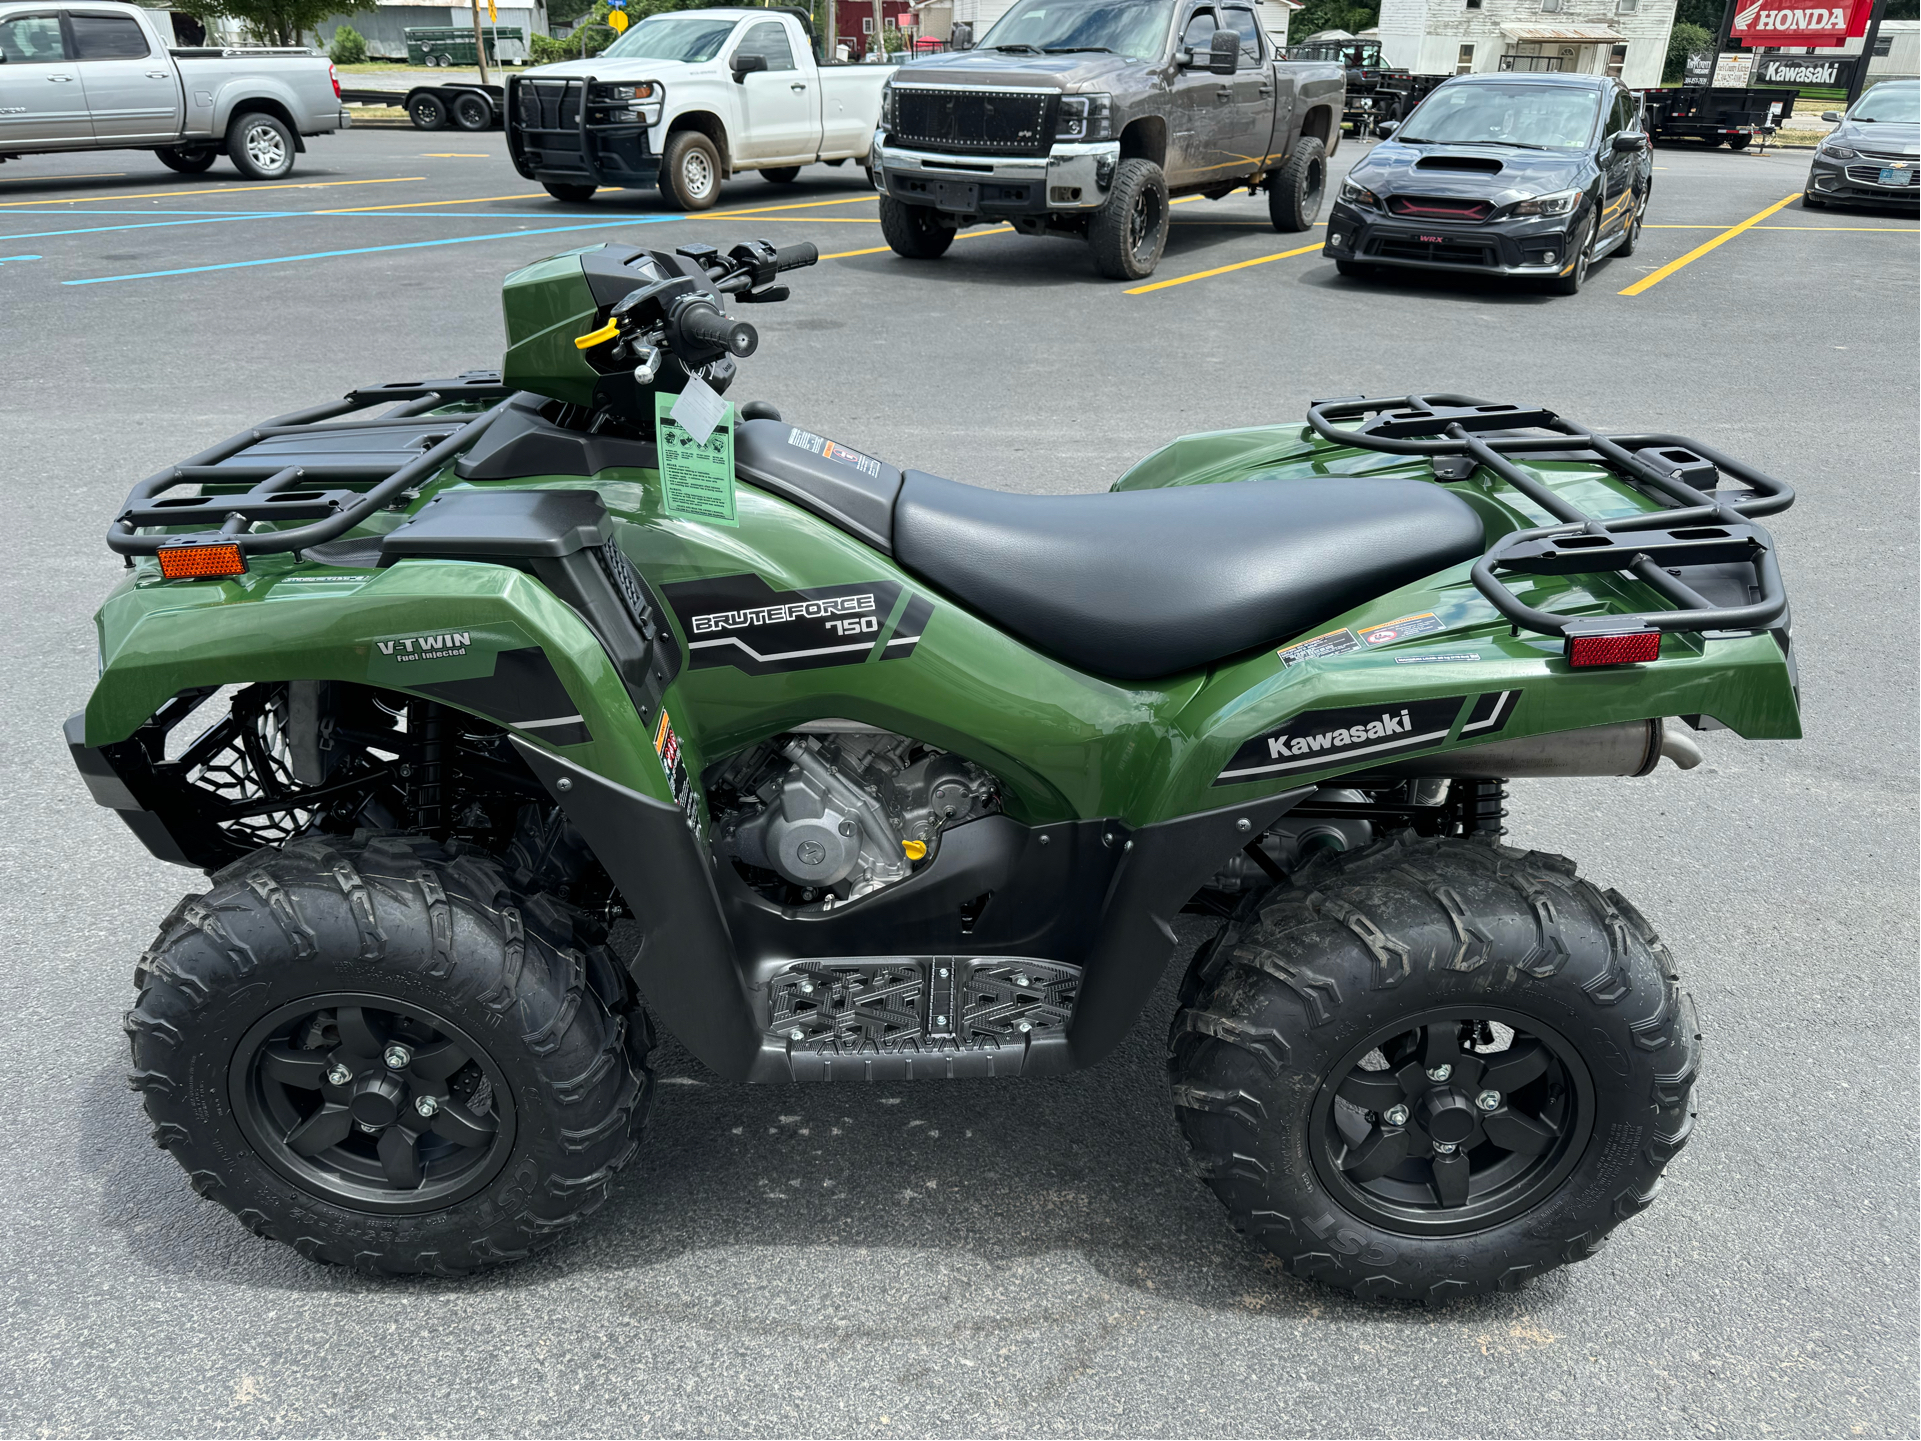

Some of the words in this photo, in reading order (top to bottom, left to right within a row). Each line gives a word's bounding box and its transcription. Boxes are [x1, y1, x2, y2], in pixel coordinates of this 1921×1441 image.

[1756, 8, 1846, 30] HONDA
[1765, 61, 1839, 84] Kawasaki
[1420, 235, 1443, 243] WRX
[692, 605, 786, 634] BRUTE
[785, 594, 876, 621] FORCE
[825, 616, 879, 636] 750
[376, 632, 471, 655] V-TWIN
[396, 653, 419, 663] Fuel
[421, 648, 467, 660] Injected
[1267, 709, 1412, 759] Kawasaki
[478, 1158, 539, 1232] CST
[1301, 1211, 1399, 1267] CST
